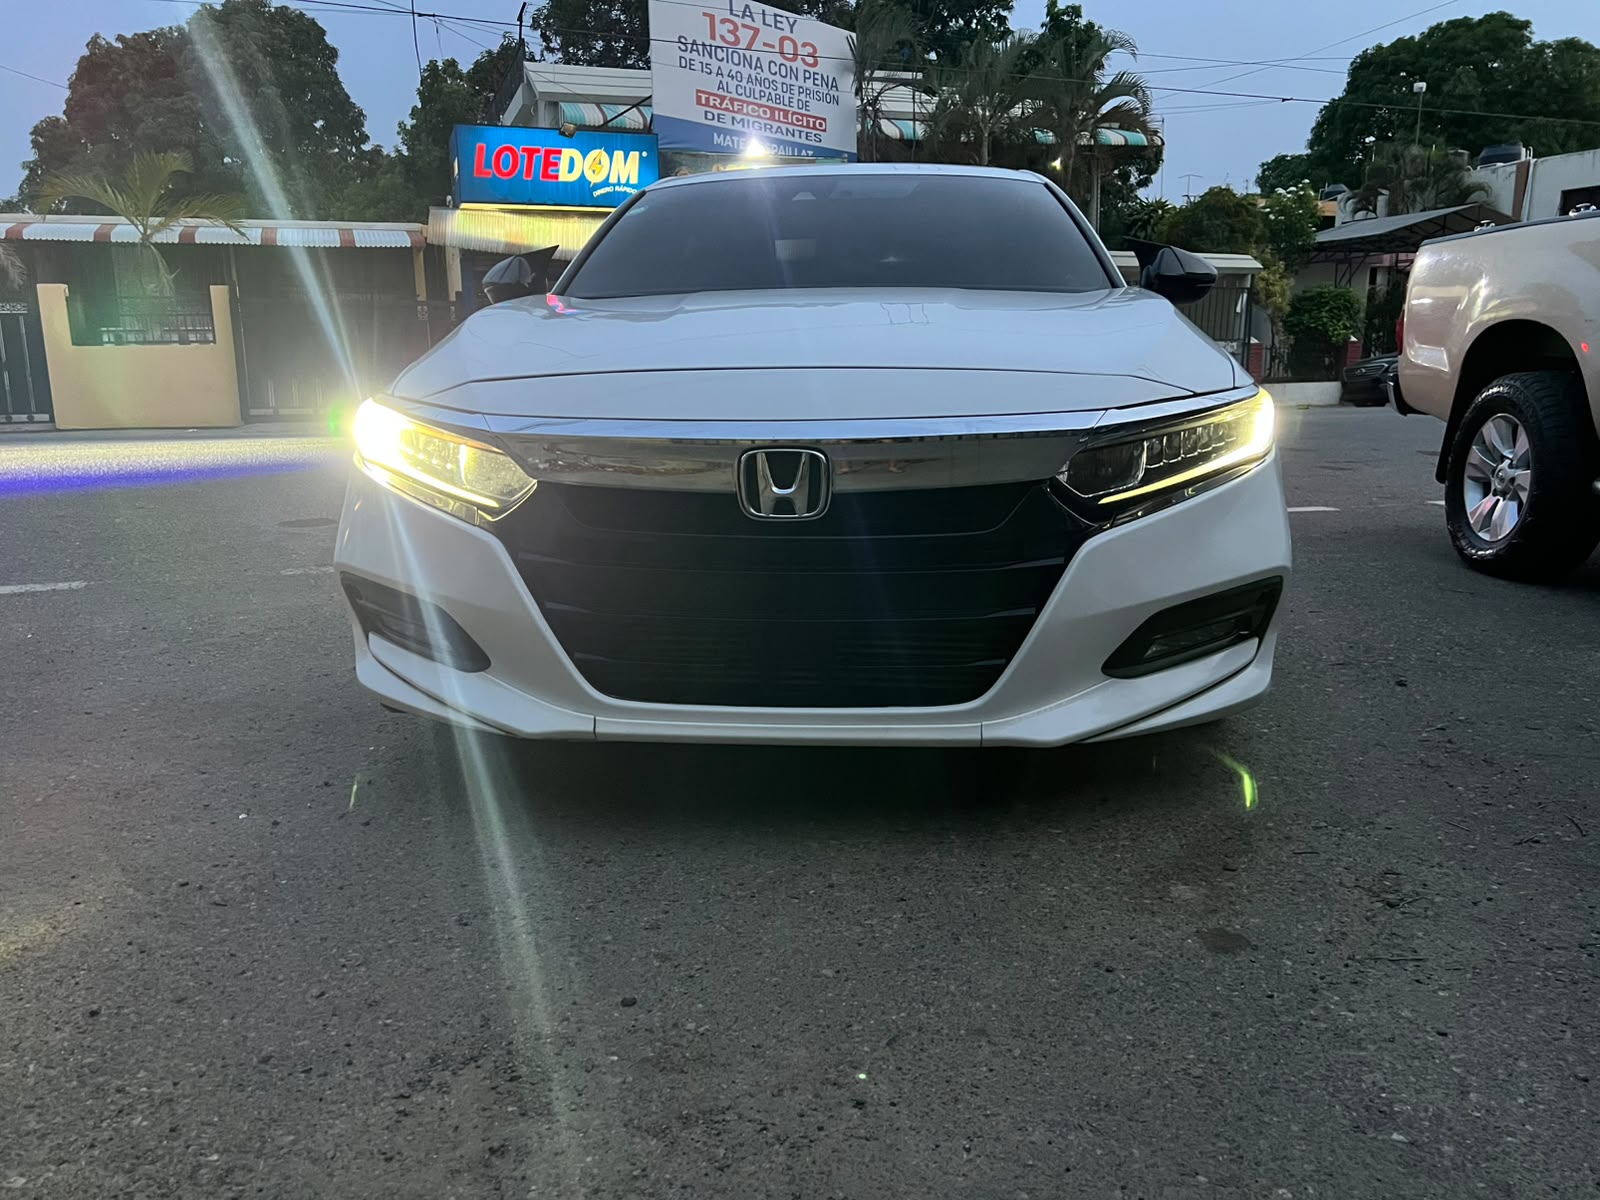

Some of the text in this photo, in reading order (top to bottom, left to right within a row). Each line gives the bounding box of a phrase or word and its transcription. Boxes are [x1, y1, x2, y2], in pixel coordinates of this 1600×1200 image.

[728, 0, 798, 34] LA LEY
[701, 11, 819, 68] 137-03
[677, 35, 839, 92] SANCIONA CON PENA
[678, 56, 839, 106] DE 15 A 40 AÑOS DE PRISIÓN
[698, 91, 826, 130] TRÁFICO ILÍCITO
[717, 80, 811, 112] AL CULPABLE DE
[704, 110, 823, 143] DE MIGRANTES
[713, 132, 754, 151] MATE
[474, 143, 640, 186] LOTEDOM
[592, 185, 614, 197] DINERO
